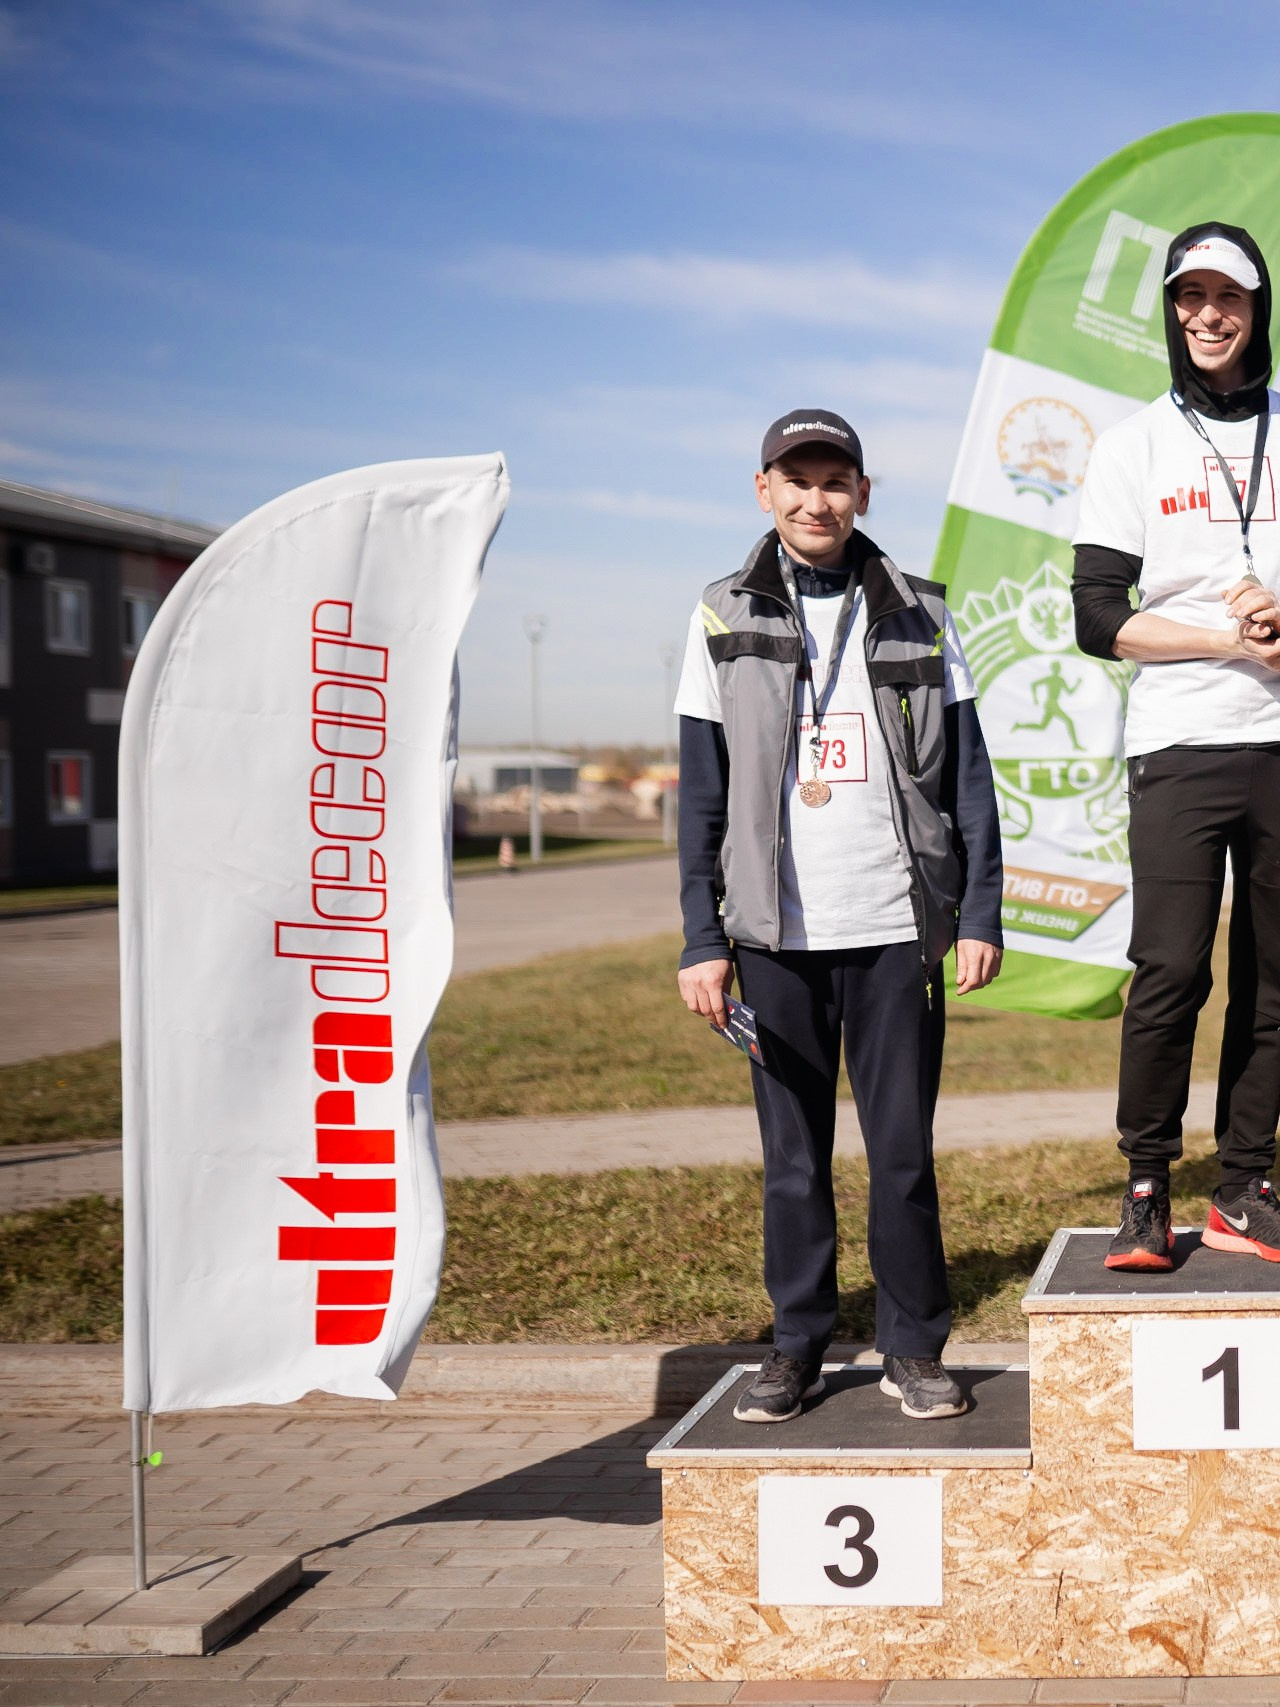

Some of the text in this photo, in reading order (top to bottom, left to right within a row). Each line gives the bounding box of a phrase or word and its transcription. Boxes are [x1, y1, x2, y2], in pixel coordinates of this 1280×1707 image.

[1081, 210, 1177, 321] ГТ
[819, 739, 847, 769] 73
[1018, 760, 1099, 792] ГТО
[1003, 873, 1044, 901] ТИВ
[1045, 882, 1088, 908] ГТО
[274, 599, 396, 1346] ultradecor
[1202, 1347, 1240, 1430] 1
[823, 1505, 879, 1588] 3
